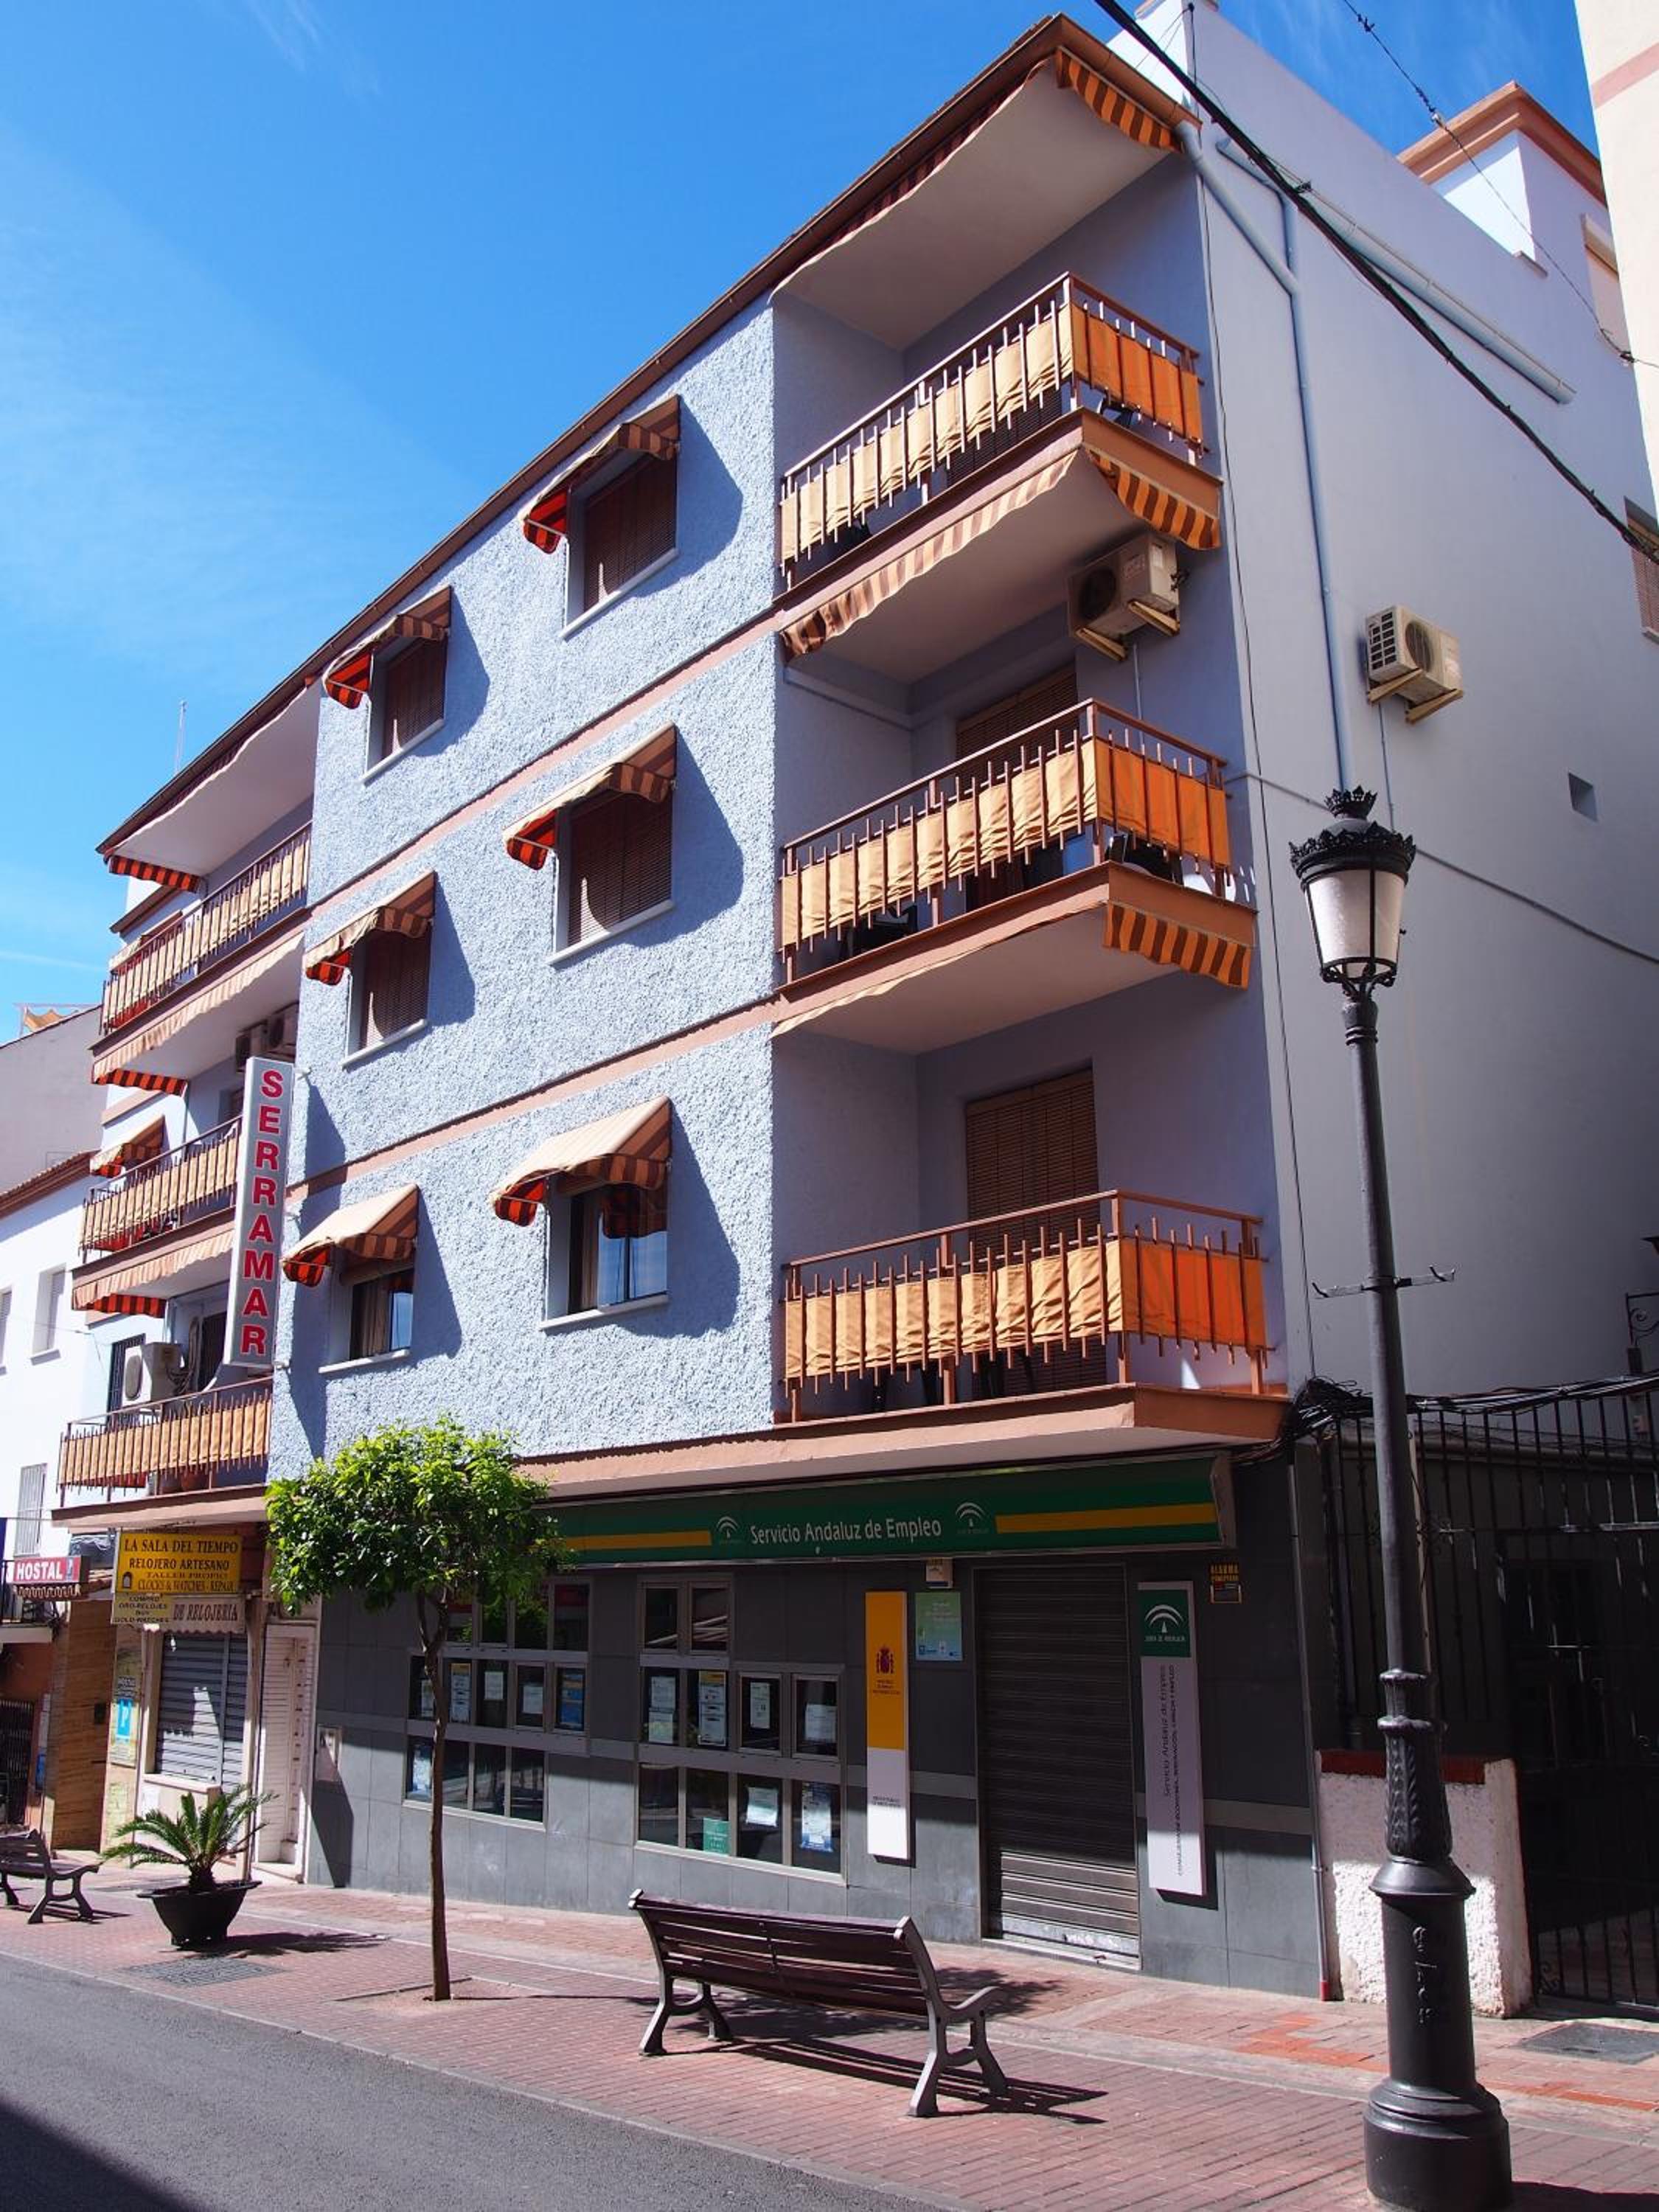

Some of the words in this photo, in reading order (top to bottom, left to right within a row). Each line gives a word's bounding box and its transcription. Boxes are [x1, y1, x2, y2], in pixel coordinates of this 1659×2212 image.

[240, 1068, 285, 1355] SERRAMAR
[750, 1524, 801, 1544] Servicio
[804, 1521, 861, 1541] Andaluz
[865, 1519, 882, 1539] de
[886, 1517, 942, 1542] Empleo
[125, 1538, 138, 1551] LA
[142, 1539, 168, 1552] SALA
[173, 1540, 193, 1553] DEL
[198, 1540, 238, 1554] TIEMPO
[16, 1561, 63, 1580] HOSTAL
[129, 1557, 176, 1570] RELOJERO
[180, 1559, 229, 1571] ARTESANO
